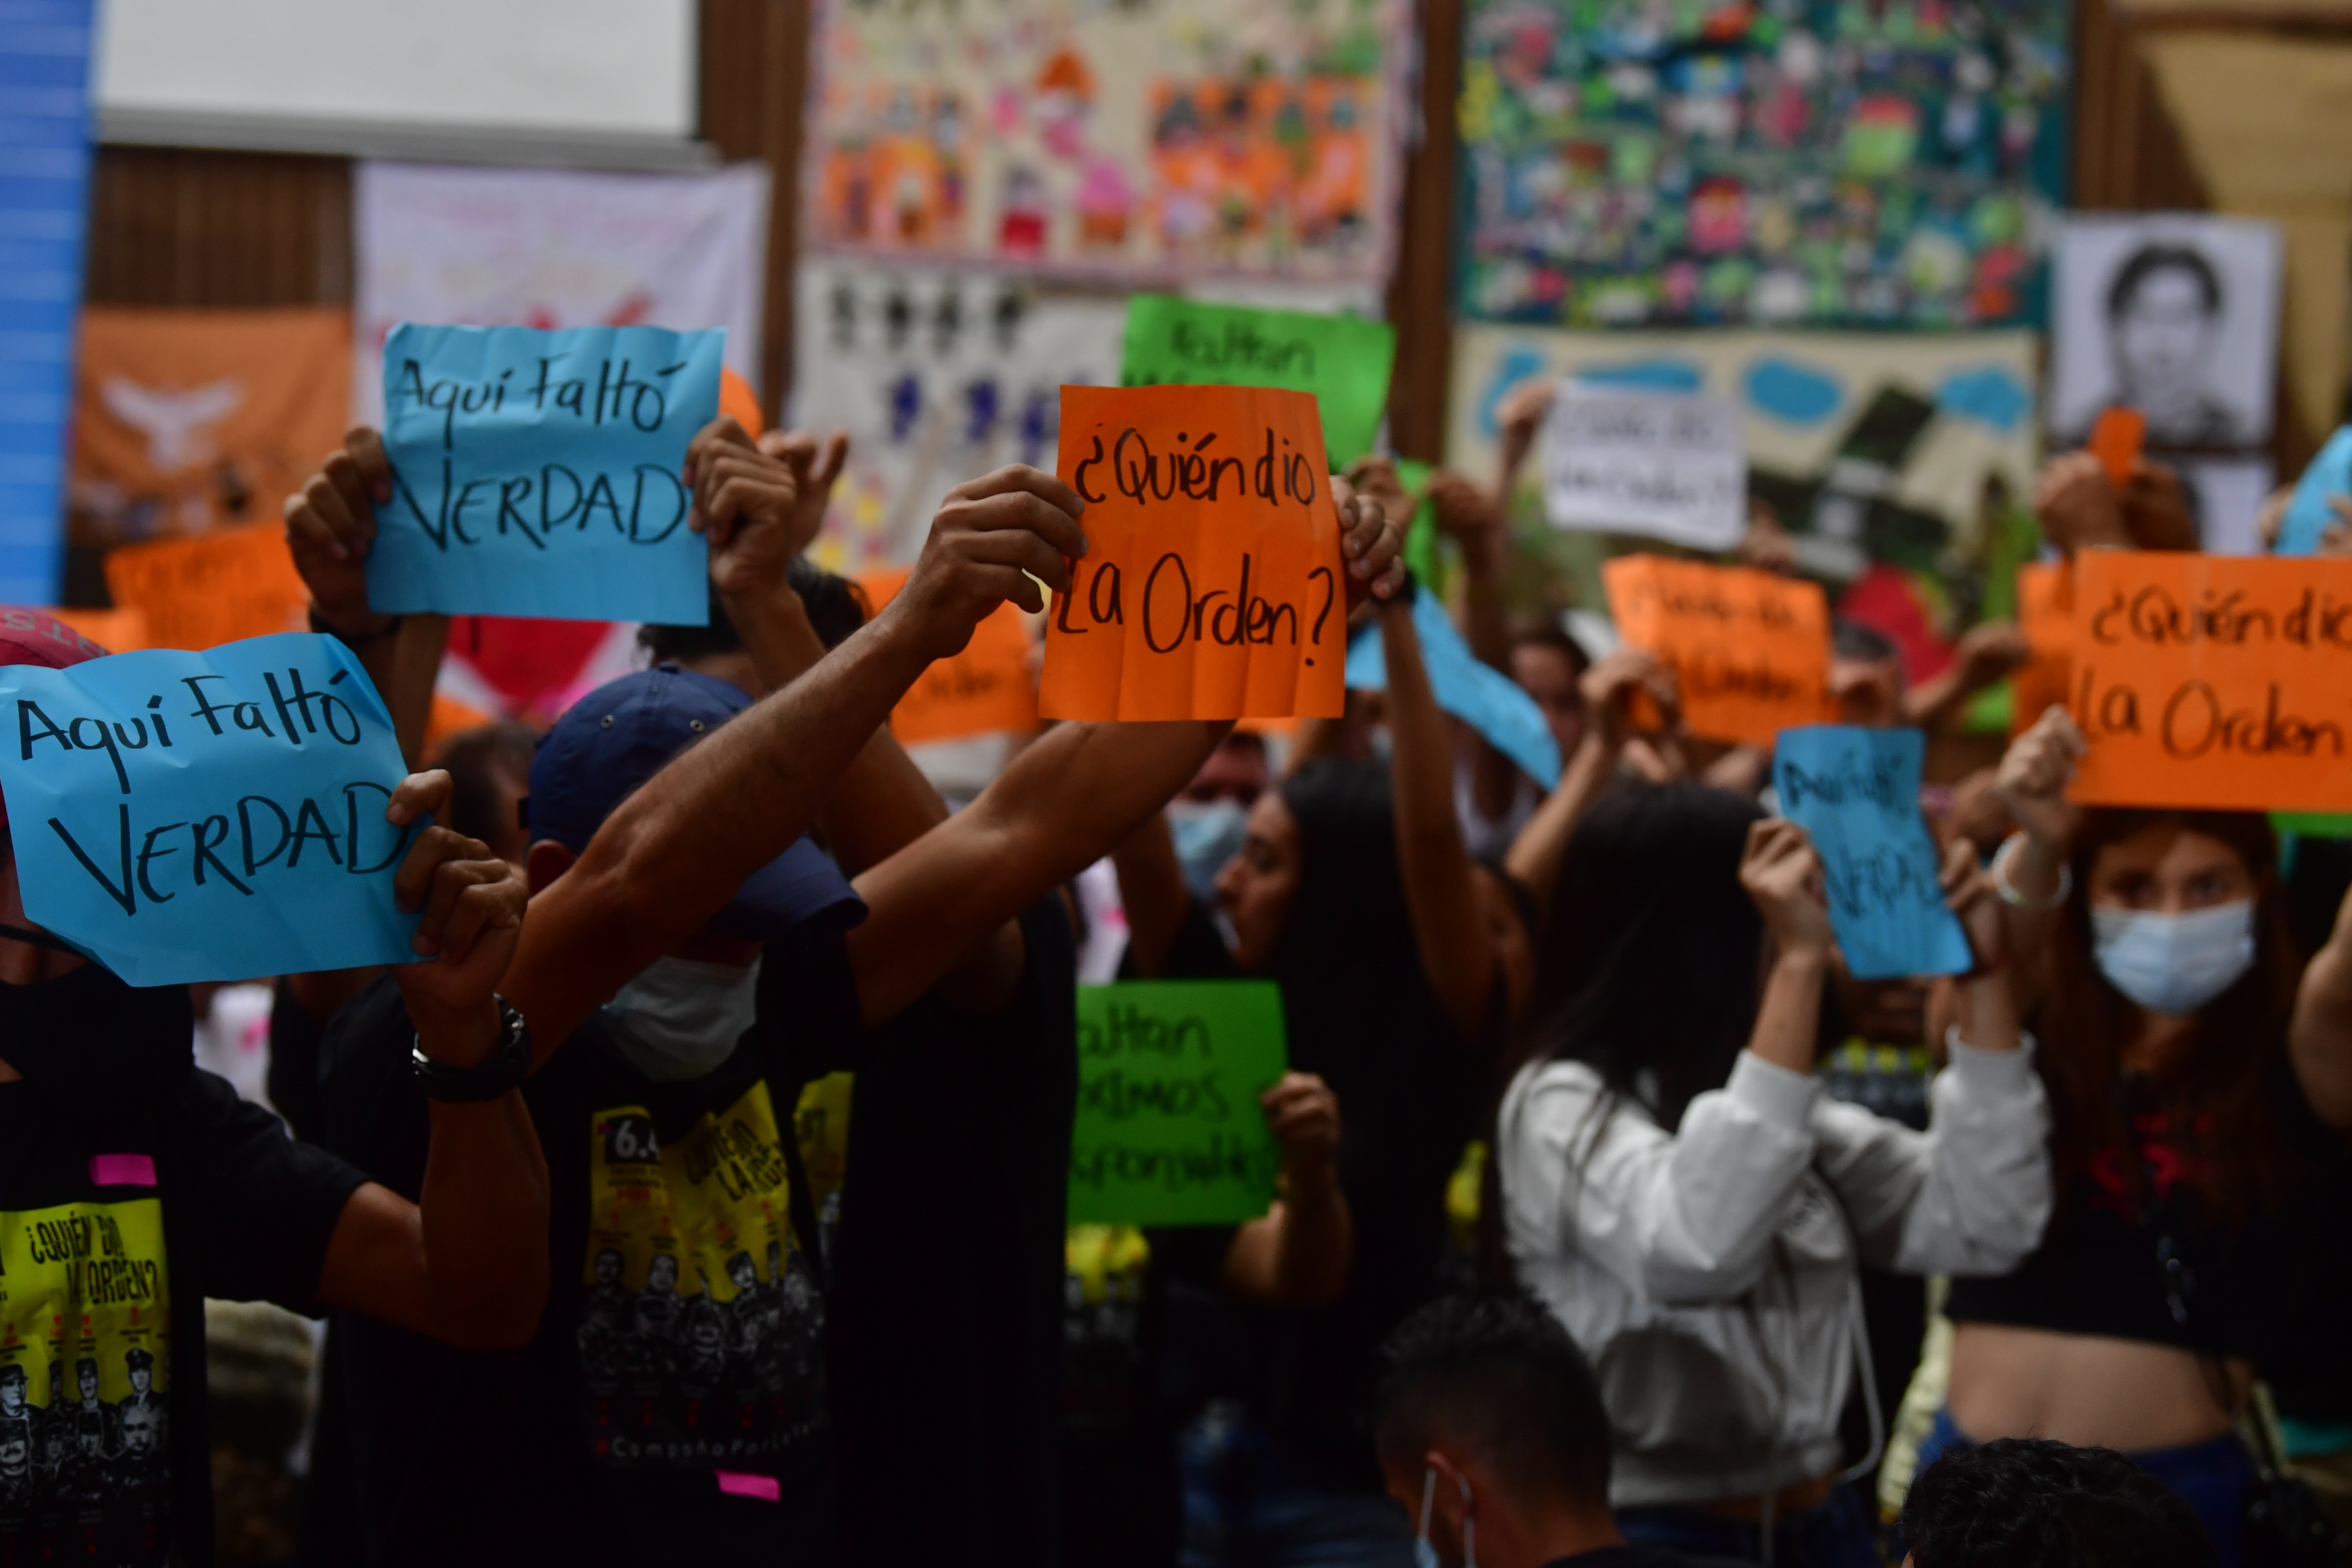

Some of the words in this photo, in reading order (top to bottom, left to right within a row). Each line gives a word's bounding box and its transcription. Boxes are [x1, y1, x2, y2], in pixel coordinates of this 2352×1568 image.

[404, 357, 512, 450] Aquí
[528, 351, 687, 433] Faltó
[391, 457, 691, 551] VERDAD
[1075, 423, 1245, 505] ¿Quién
[1255, 427, 1315, 506] dio
[1143, 553, 1334, 667] Orden?
[17, 694, 172, 794] Aquí
[182, 667, 361, 746] Faltó
[48, 781, 409, 916] VERDAD
